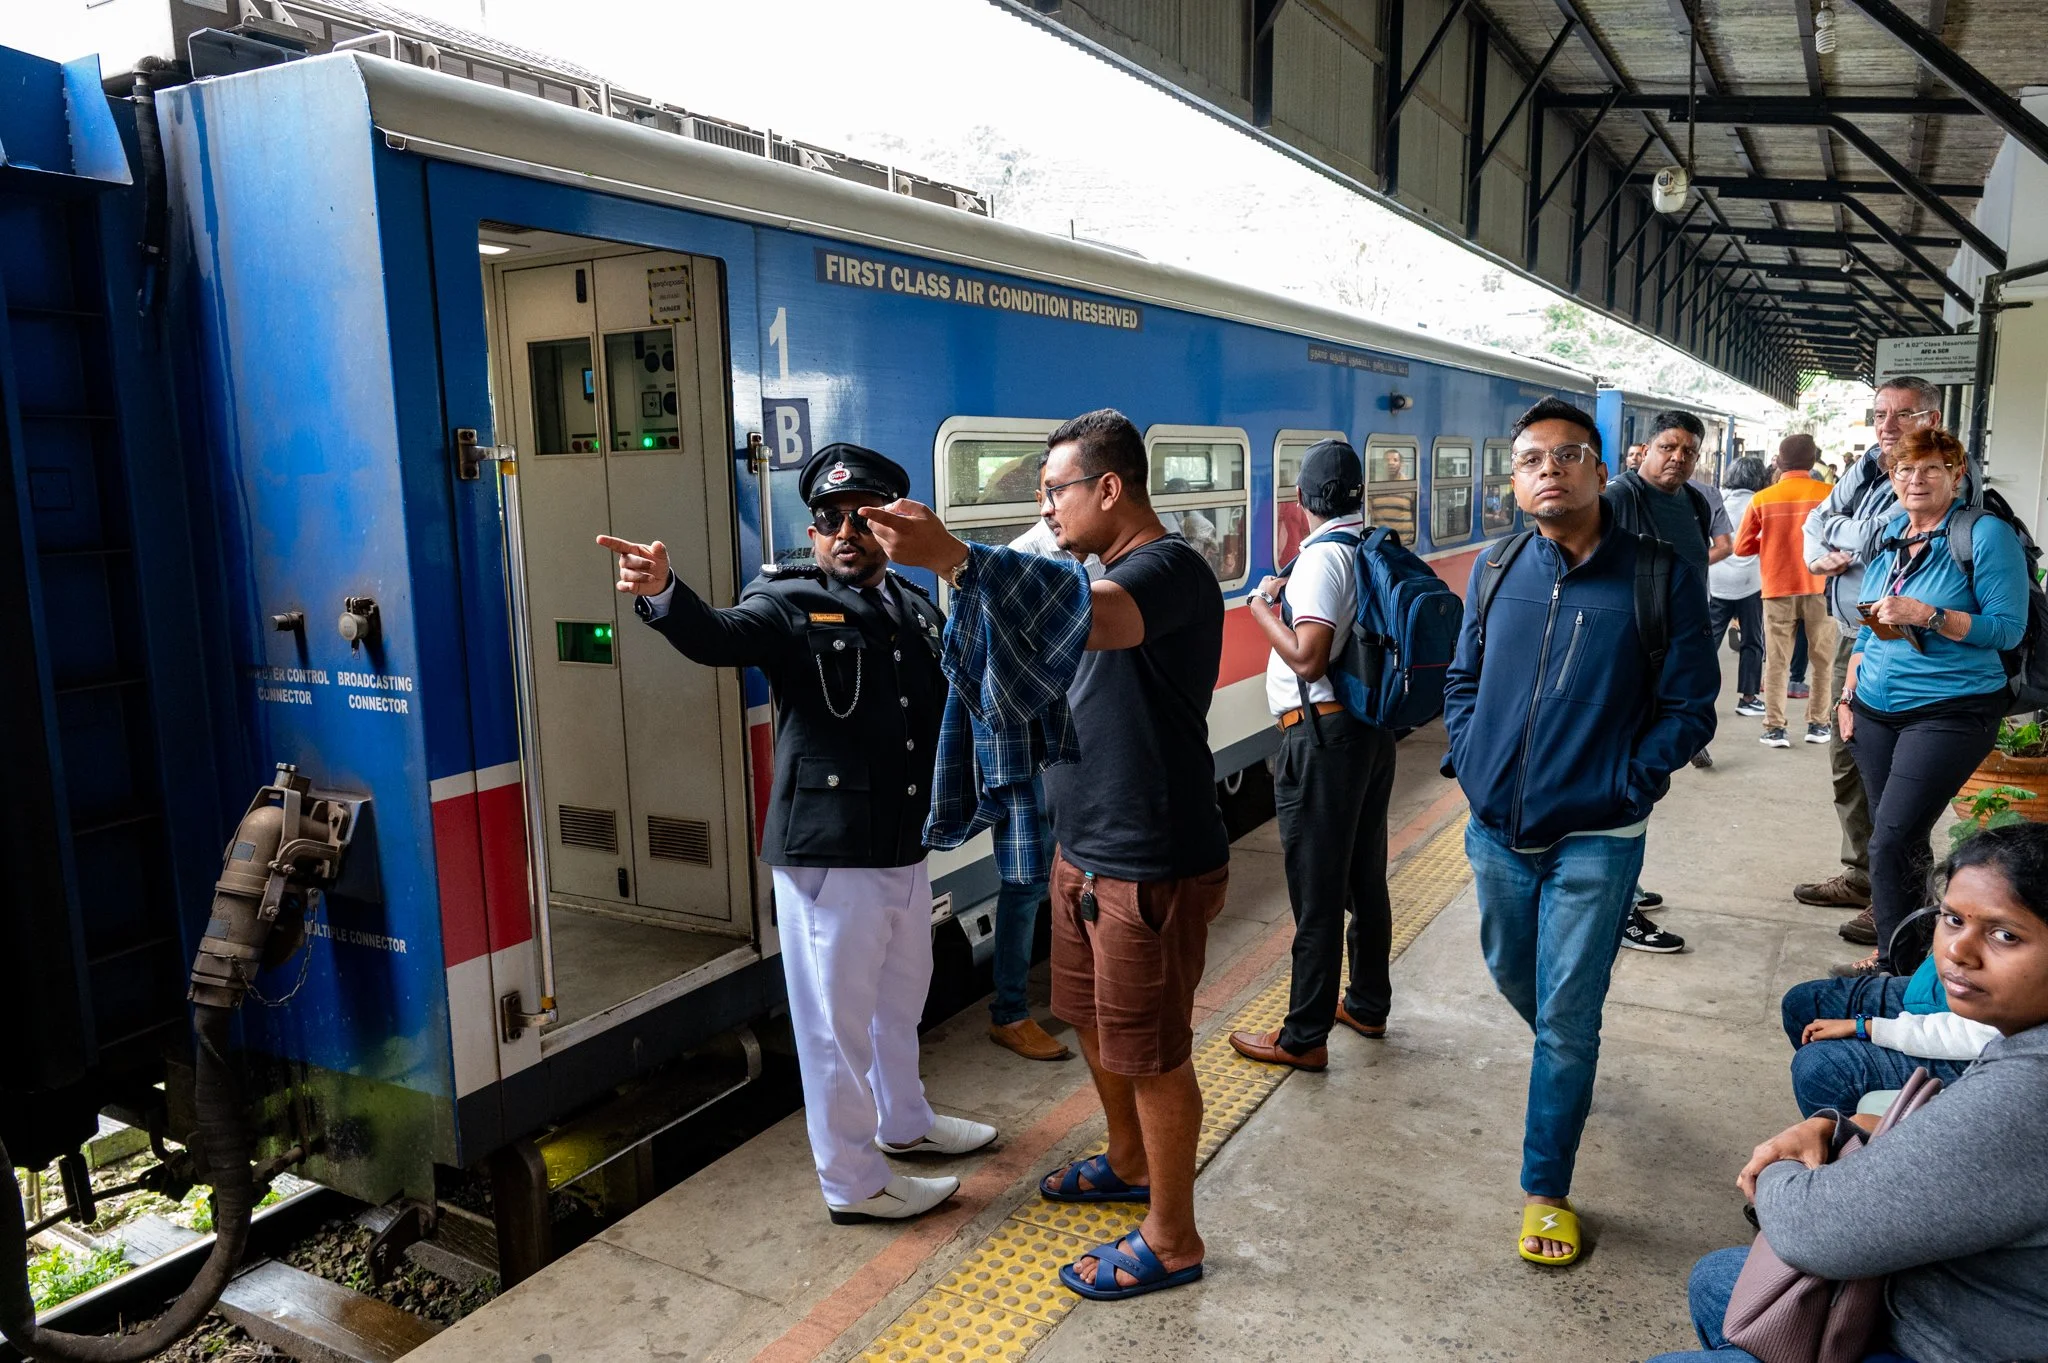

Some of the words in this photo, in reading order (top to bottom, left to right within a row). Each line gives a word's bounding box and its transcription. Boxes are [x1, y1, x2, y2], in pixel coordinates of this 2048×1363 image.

[826, 254, 886, 289] FIRST
[890, 266, 951, 299] CLASS
[955, 278, 984, 305] AIR
[988, 284, 1069, 319] CONDITION
[1072, 300, 1138, 329] RESERVED
[769, 307, 790, 383] 1
[776, 405, 803, 464] B
[287, 668, 330, 685] CONTROL
[337, 671, 413, 692] BROADCASTING
[257, 686, 312, 705] CONNECTOR
[348, 694, 409, 714] CONNECTOR
[349, 930, 407, 954] CONNECTOR
